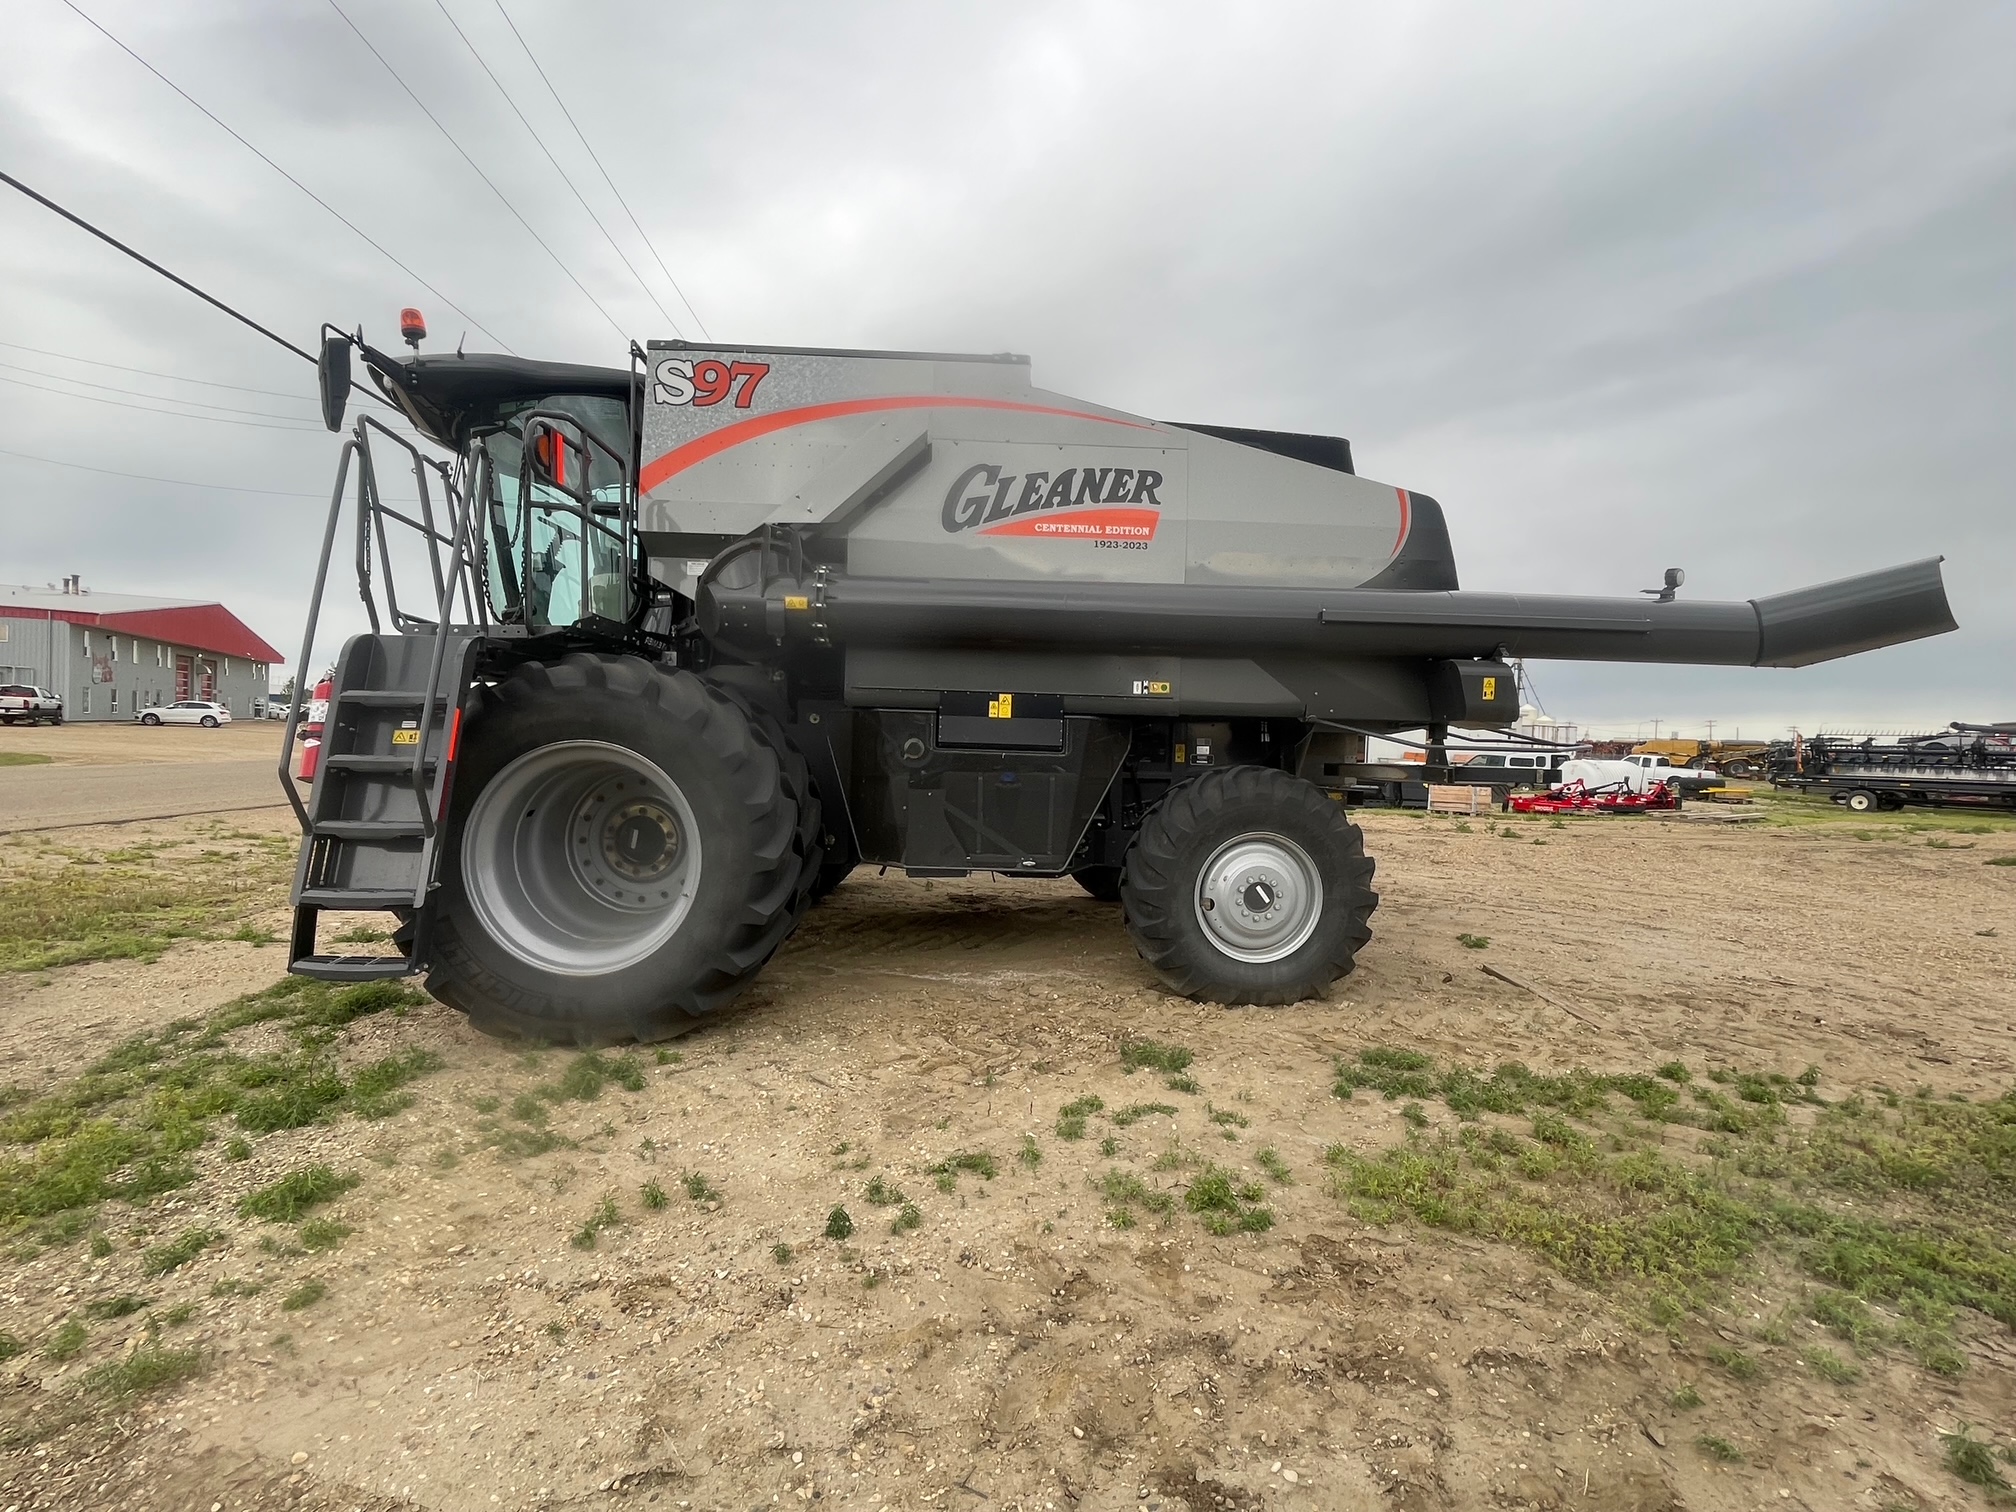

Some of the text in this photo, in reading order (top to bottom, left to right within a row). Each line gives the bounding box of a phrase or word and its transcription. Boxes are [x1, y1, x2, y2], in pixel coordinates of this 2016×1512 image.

[653, 358, 770, 408] S97
[941, 463, 1164, 533] GLEANER
[1034, 523, 1150, 536] CENTENNIAL EDITION
[1093, 540, 1149, 550] 1923-2023
